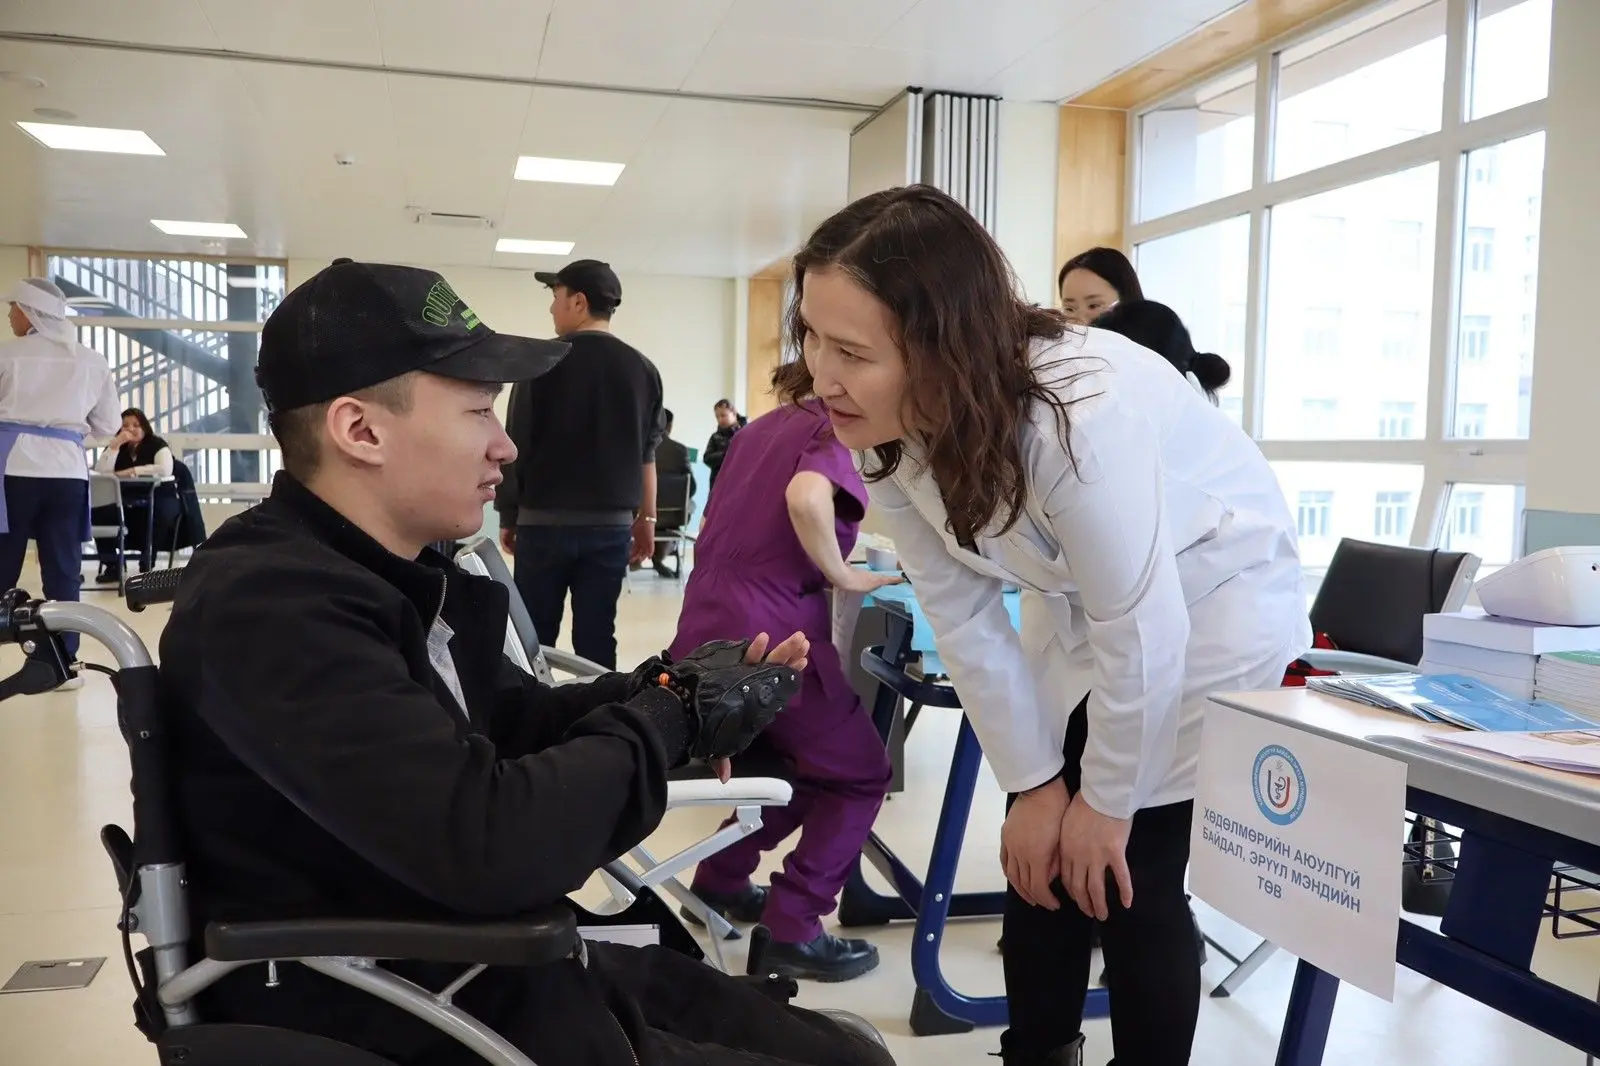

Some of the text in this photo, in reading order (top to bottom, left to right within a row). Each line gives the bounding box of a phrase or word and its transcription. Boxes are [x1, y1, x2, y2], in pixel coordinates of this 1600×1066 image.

[1203, 825, 1361, 914] БАЙДАЛ, ЭРҮҮЛ МЭНДИЙН
[1204, 807, 1361, 890] ХӨДӨЛМӨРИЙН АЮУЛГҮЙ
[1257, 875, 1282, 900] ТӨВ
